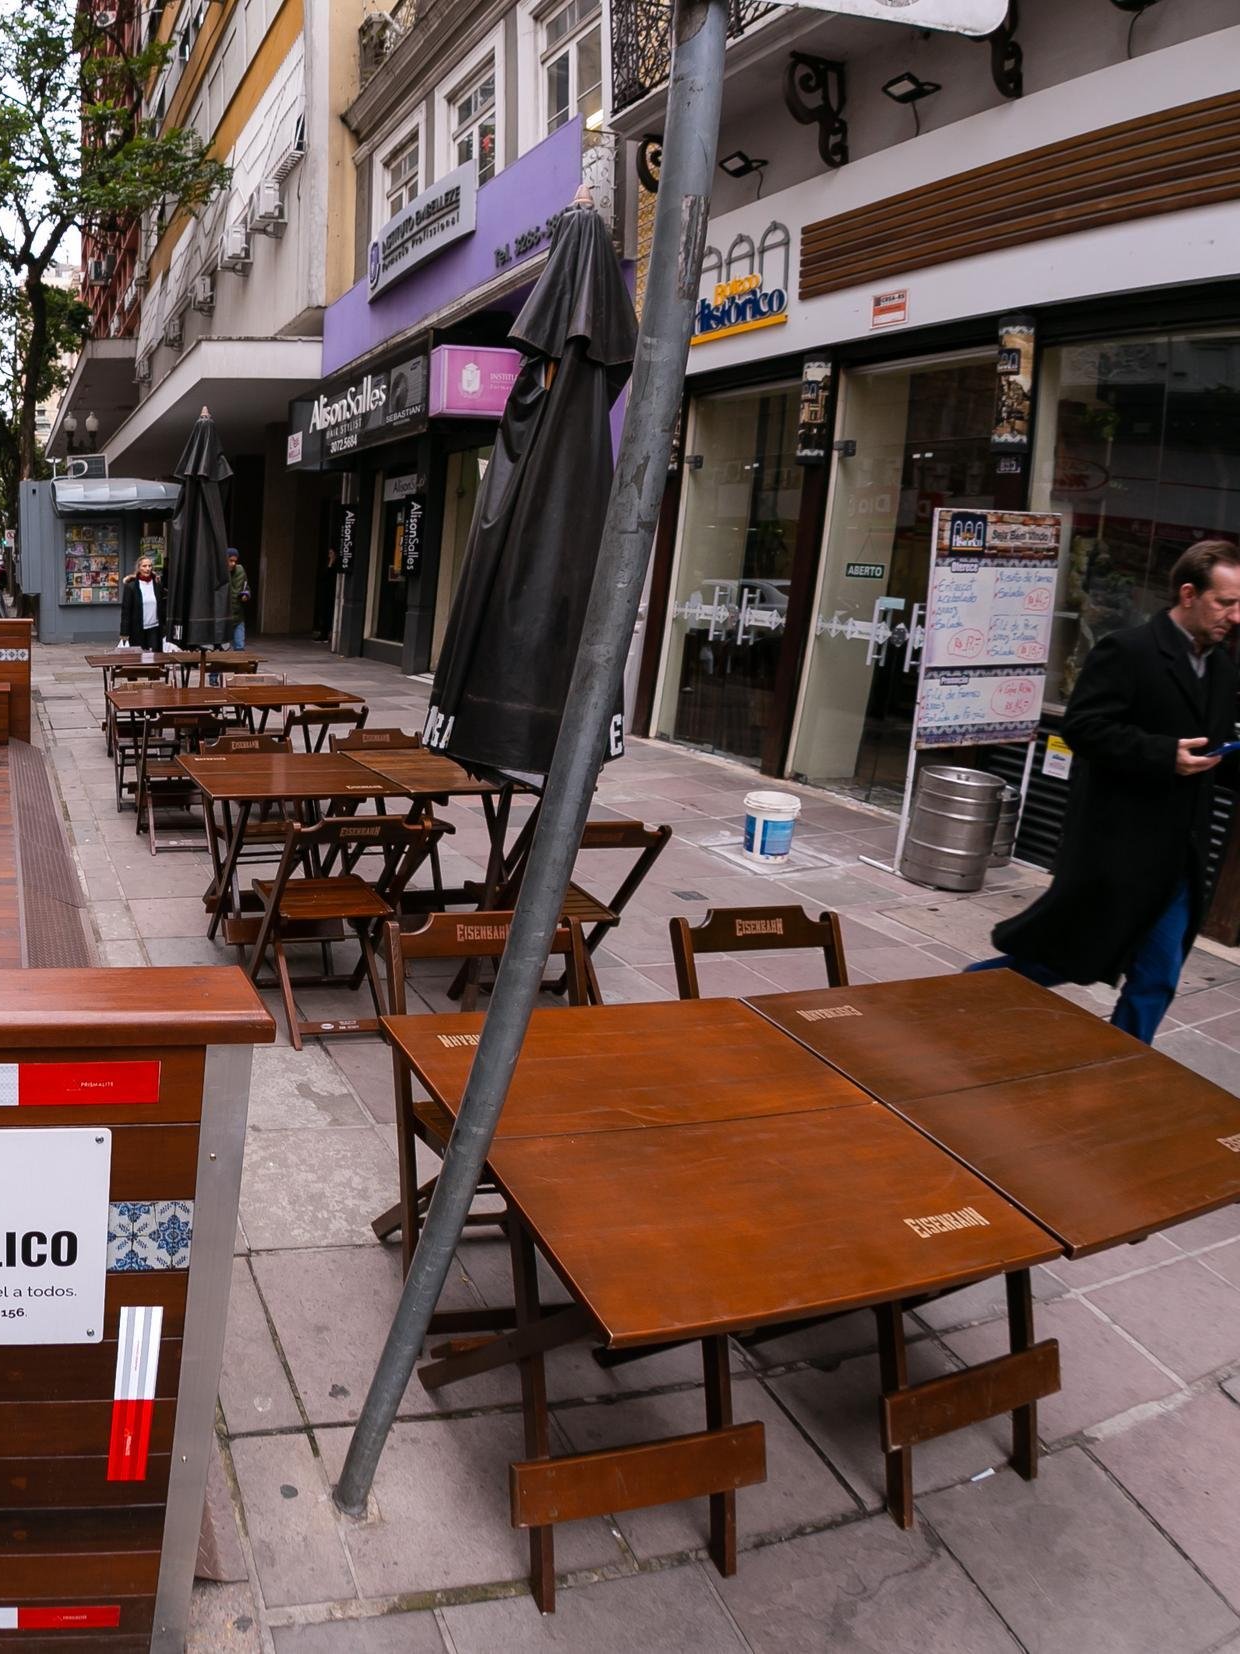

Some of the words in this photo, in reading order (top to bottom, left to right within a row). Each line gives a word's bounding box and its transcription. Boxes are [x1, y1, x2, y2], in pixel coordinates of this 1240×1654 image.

[382, 216, 415, 254] INSTITUTO
[385, 405, 421, 424] SEBASTIAN
[406, 501, 423, 571] AlisonSalles
[847, 565, 882, 577] ABERTO
[735, 918, 784, 936] EISENBAHN
[796, 1004, 864, 1022] EISENBAHN
[903, 1206, 991, 1239] EISENBAHN
[13, 1288, 23, 1297] a
[27, 1285, 77, 1298] todos.
[1, 1307, 28, 1319] 156.
